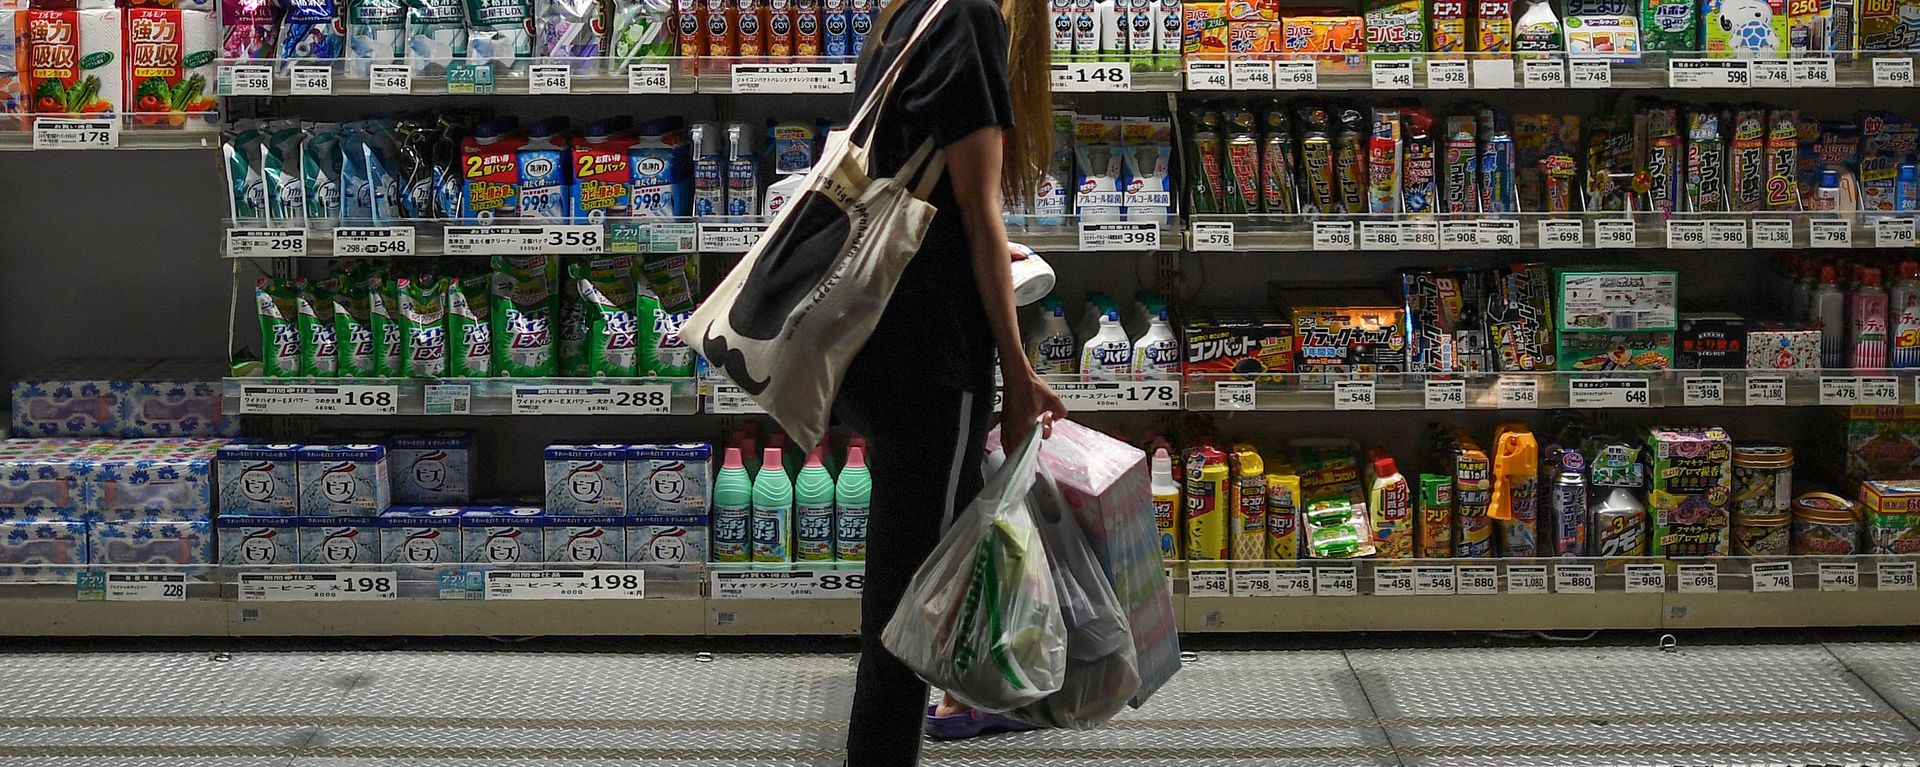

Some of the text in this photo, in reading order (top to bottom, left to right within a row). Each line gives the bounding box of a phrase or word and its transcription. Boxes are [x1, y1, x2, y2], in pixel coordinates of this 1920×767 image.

[1433, 2, 1462, 15] ダニアース
[1480, 2, 1510, 15] ダニアース
[681, 21, 697, 29] JOY
[710, 21, 726, 29] JOY
[740, 20, 756, 29] JOY
[772, 21, 788, 29] JOY
[801, 21, 817, 29] JOY
[829, 21, 845, 29] JOY
[855, 21, 870, 29] JOY
[1057, 19, 1071, 28] JOY
[1078, 19, 1093, 28] JOY
[1133, 19, 1149, 28] JOY
[31, 19, 72, 43] 強力
[133, 18, 175, 43] 強力
[1368, 27, 1422, 43] コバエよけ
[33, 44, 74, 68] 吸収
[134, 43, 177, 68] 吸収
[450, 69, 474, 77] アプリ
[1076, 68, 1124, 83] 148
[1249, 73, 1269, 82] 448
[1294, 73, 1312, 82] 698
[1445, 72, 1464, 82] 928
[1542, 72, 1561, 82] 698
[1588, 72, 1607, 81] 748
[1728, 71, 1747, 83] 598
[1768, 70, 1787, 80] 748
[1808, 70, 1827, 80] 848
[1890, 71, 1910, 81] 698
[248, 79, 269, 88] 598
[308, 78, 328, 88] 648
[387, 78, 407, 87] 648
[546, 77, 566, 86] 648
[646, 77, 666, 86] 648
[1208, 75, 1226, 85] 448
[1392, 74, 1410, 84] 448
[79, 132, 110, 142] 178
[1078, 194, 1121, 204] アルコール除菌
[1126, 194, 1169, 204] アルコール除菌
[548, 232, 598, 246] 358
[1124, 233, 1156, 244] 398
[1210, 234, 1230, 244] 578
[1330, 234, 1350, 244] 908
[1377, 234, 1397, 243] 880
[1415, 233, 1435, 243] 880
[1456, 232, 1476, 242] 908
[1496, 234, 1514, 245] 980
[1560, 232, 1580, 242] 698
[1612, 232, 1632, 242] 980
[1684, 232, 1703, 242] 698
[1723, 232, 1742, 242] 980
[1770, 232, 1788, 243] 1,380
[1827, 232, 1846, 241] 798
[1893, 230, 1912, 240] 780
[271, 239, 303, 250] 298
[346, 244, 360, 252] 298
[379, 240, 406, 252] 548
[1300, 325, 1397, 346] ブラックキャップ
[1189, 338, 1257, 363] コンバット
[1126, 386, 1173, 401] 178
[1351, 393, 1370, 402] 548
[1514, 392, 1534, 402] 548
[1626, 391, 1646, 403] 648
[1700, 390, 1720, 399] 398
[1763, 389, 1782, 400] 1,180
[1836, 388, 1856, 398] 478
[1876, 388, 1894, 398] 478
[344, 392, 392, 406] 168
[616, 392, 664, 406] 288
[1232, 394, 1252, 404] 548
[1442, 393, 1461, 404] 748
[245, 480, 269, 495] ビーズ
[326, 480, 351, 495] ビーズ
[573, 480, 597, 495] ビーズ
[655, 480, 679, 495] ビーズ
[245, 546, 270, 560] ビーズ
[327, 546, 352, 560] ビーズ
[408, 546, 433, 560] ビーズ
[490, 546, 515, 560] ビーズ
[572, 546, 597, 560] ビーズ
[654, 545, 679, 559] ビーズ
[81, 576, 103, 584] アプリ
[442, 575, 465, 583] アプリ
[591, 575, 638, 590] 198
[820, 575, 866, 590] 88
[1392, 580, 1411, 588] 458
[1432, 579, 1451, 588] 548
[1474, 578, 1494, 588] 880
[1524, 578, 1544, 589] 1,080
[1572, 578, 1592, 587] 880
[1642, 577, 1662, 586] 980
[1694, 576, 1714, 586] 698
[1773, 577, 1790, 587] 748
[1835, 575, 1855, 584] 448
[1894, 574, 1913, 584] 598
[344, 578, 390, 592] 198
[1206, 581, 1226, 590] 548
[1250, 580, 1269, 590] 798
[1290, 580, 1310, 589] 748
[1334, 580, 1353, 589] 448
[163, 584, 184, 596] 228
